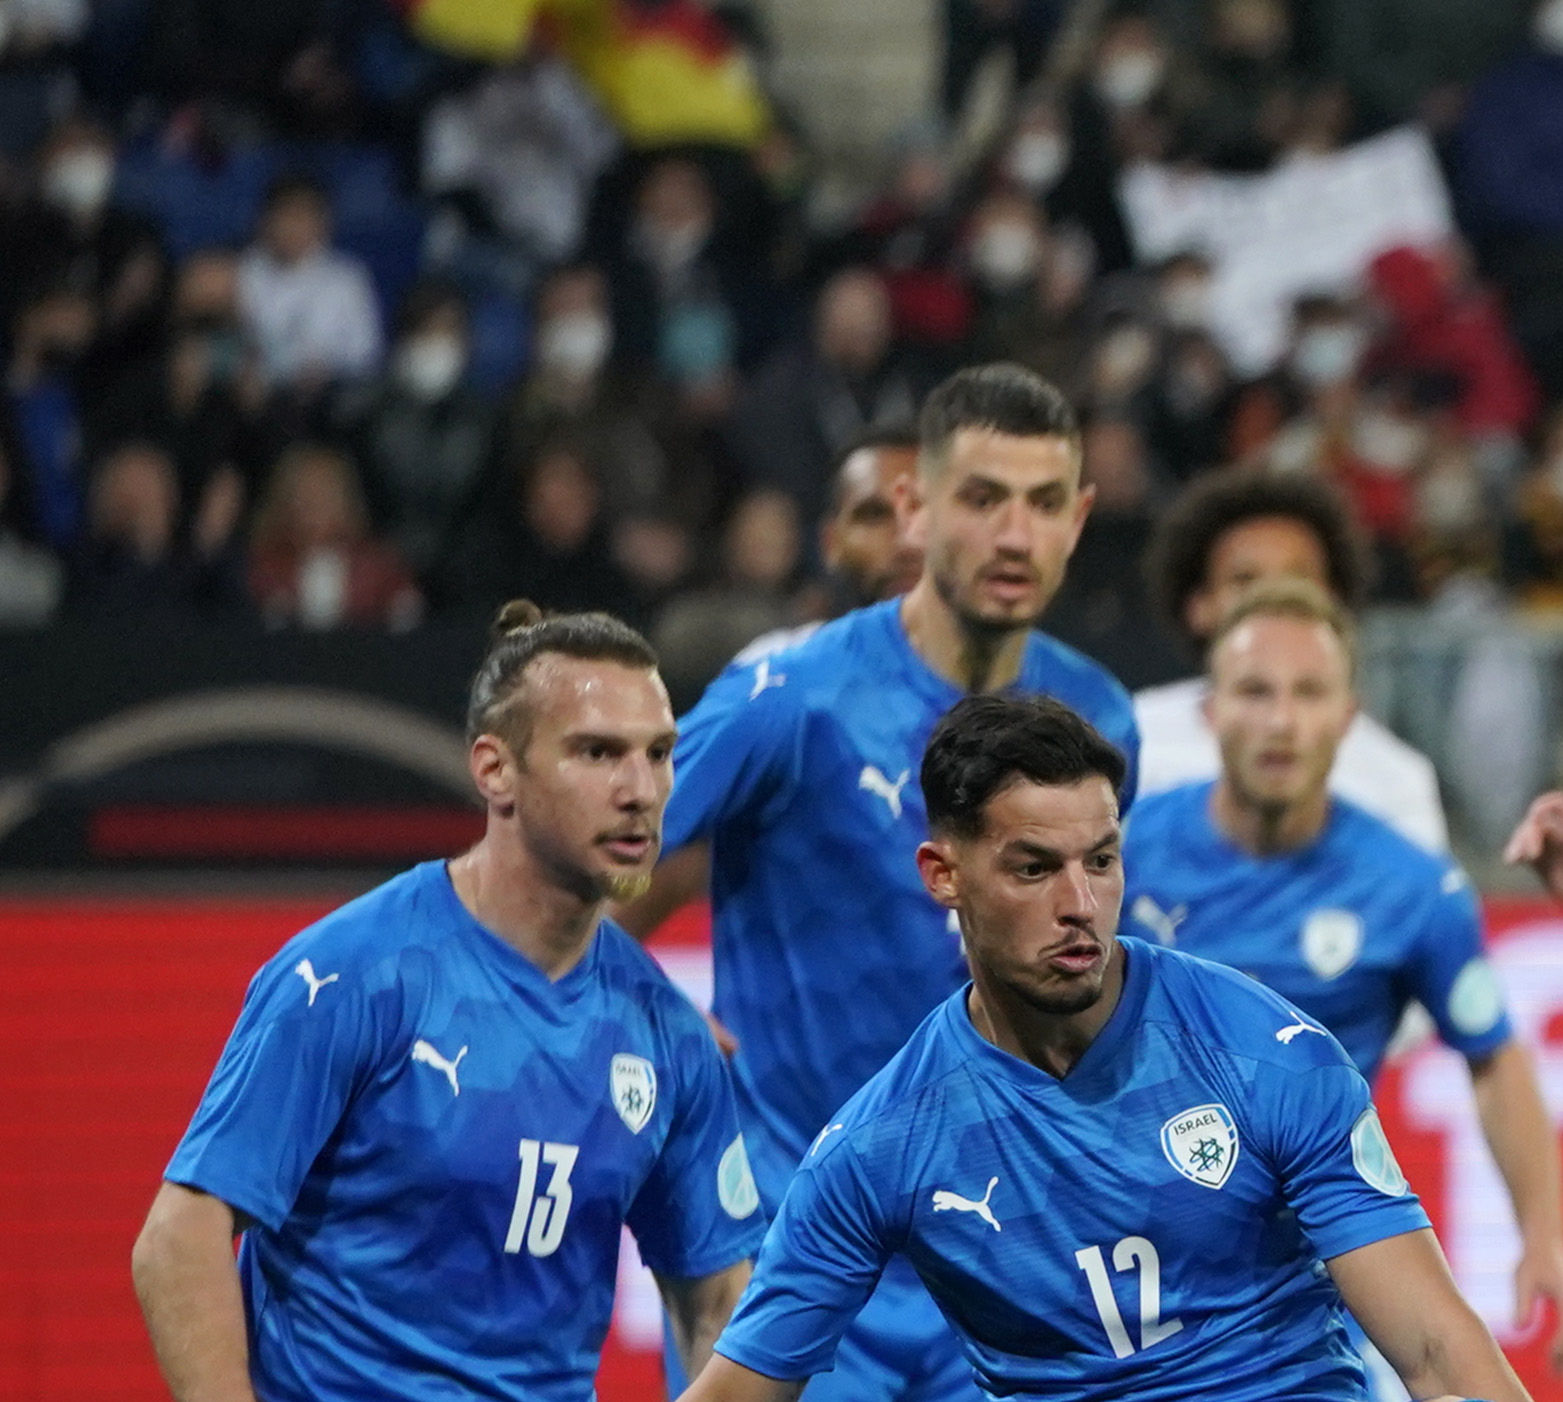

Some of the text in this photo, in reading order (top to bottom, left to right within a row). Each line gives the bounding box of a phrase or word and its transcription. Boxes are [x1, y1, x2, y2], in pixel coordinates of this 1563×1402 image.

[1174, 1113, 1218, 1135] ISRAEL
[504, 1138, 580, 1257] 13
[1075, 1236, 1184, 1358] 12
